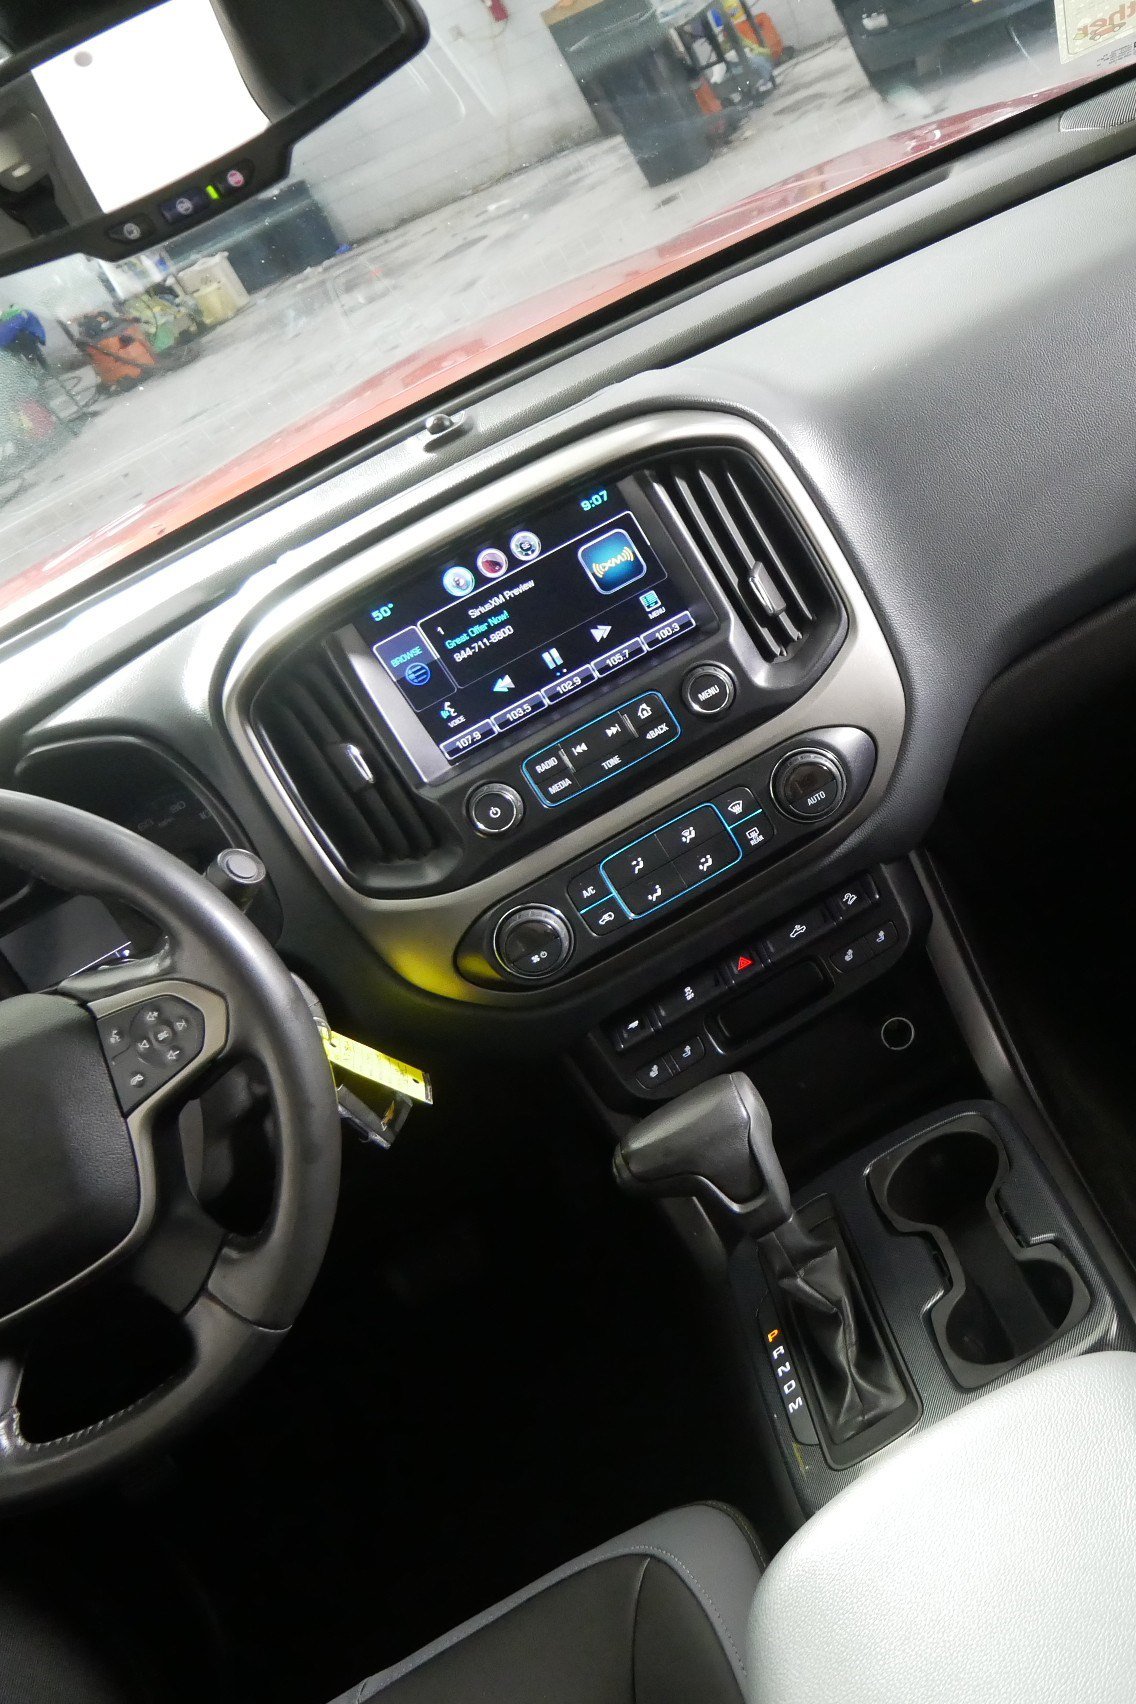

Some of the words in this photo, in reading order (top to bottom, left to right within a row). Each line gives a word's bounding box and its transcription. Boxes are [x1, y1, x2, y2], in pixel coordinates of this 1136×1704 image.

[580, 490, 608, 511] 9:07
[467, 595, 506, 619] SiriusXM
[503, 579, 535, 601] Preview
[648, 606, 666, 620] MENU
[436, 626, 445, 635] 1
[445, 633, 470, 650] Great
[468, 621, 489, 638] Offer
[488, 609, 510, 627] Now!
[453, 625, 514, 663] 844-711-8800
[390, 646, 423, 668] BROWSE
[455, 731, 482, 749] 107.9
[506, 704, 532, 722] 103.5
[556, 676, 582, 694] 102.9
[605, 649, 630, 668] 105.7
[655, 623, 680, 641] 100.3
[697, 685, 720, 702] MENU
[447, 715, 466, 728] VOICE
[650, 722, 670, 739] BACK
[535, 756, 558, 774] RADIO
[601, 754, 622, 770] TONE
[548, 777, 573, 795] MEDIA
[807, 790, 826, 806] AUTO
[749, 832, 766, 847] REAR
[582, 885, 596, 899] A/C
[767, 1329, 778, 1343] P
[772, 1345, 785, 1360] R
[777, 1362, 791, 1378] N
[783, 1379, 796, 1395] D
[788, 1396, 803, 1414] M
